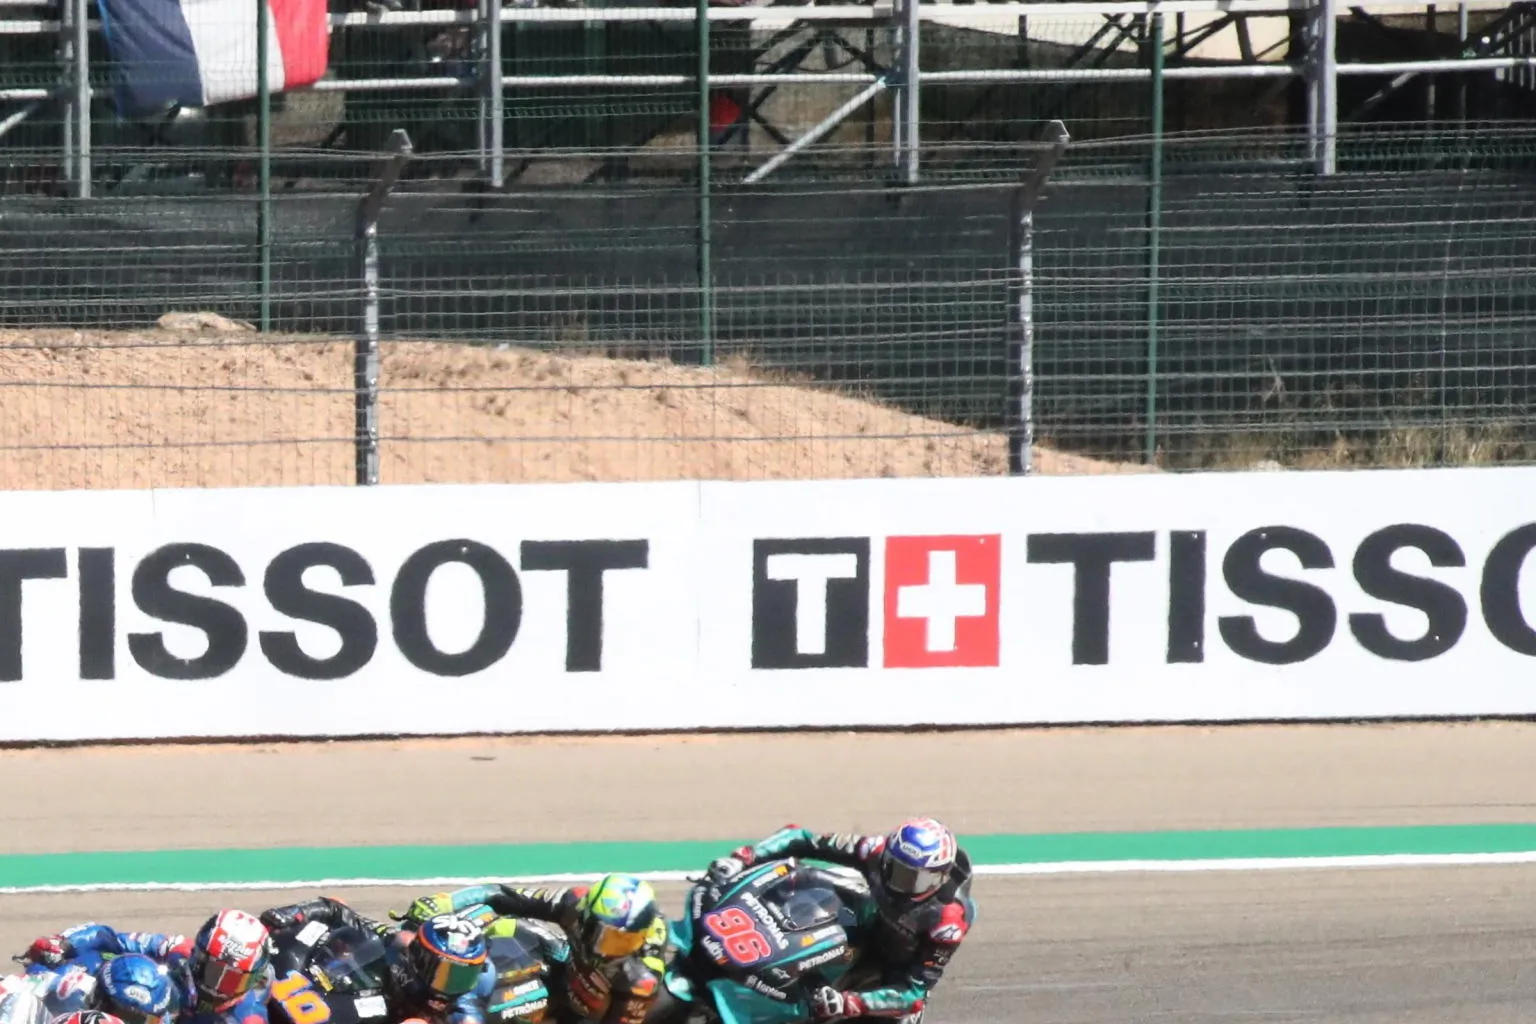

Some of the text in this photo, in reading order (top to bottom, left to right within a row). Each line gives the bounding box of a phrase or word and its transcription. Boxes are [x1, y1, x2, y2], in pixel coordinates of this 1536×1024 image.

[704, 907, 771, 965] 96
[740, 892, 789, 950] PETRONAS
[797, 946, 845, 972] PETRONAS
